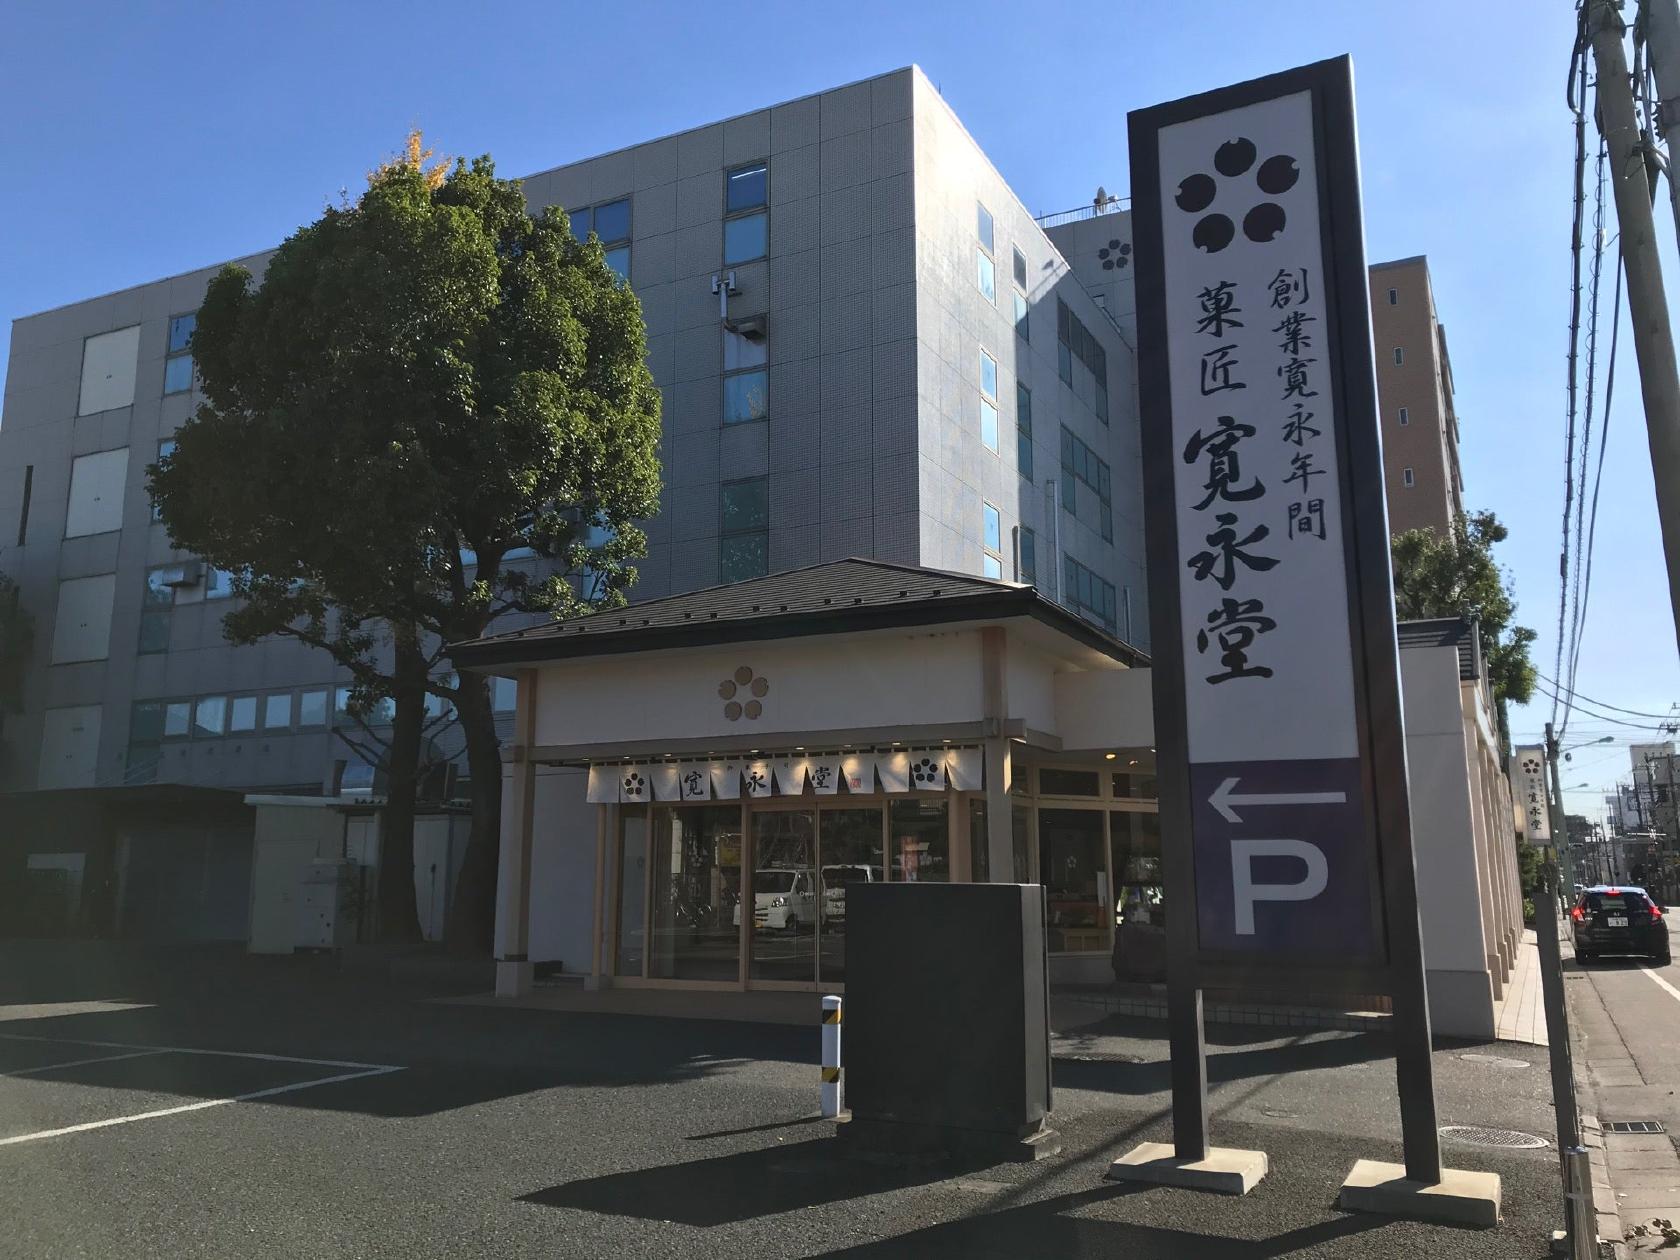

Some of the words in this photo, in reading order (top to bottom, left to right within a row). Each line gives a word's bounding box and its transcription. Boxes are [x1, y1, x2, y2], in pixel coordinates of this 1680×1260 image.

[1194, 282, 1246, 393] 菓匠
[1183, 415, 1281, 685] 寛永堂
[1231, 839, 1328, 935] P
